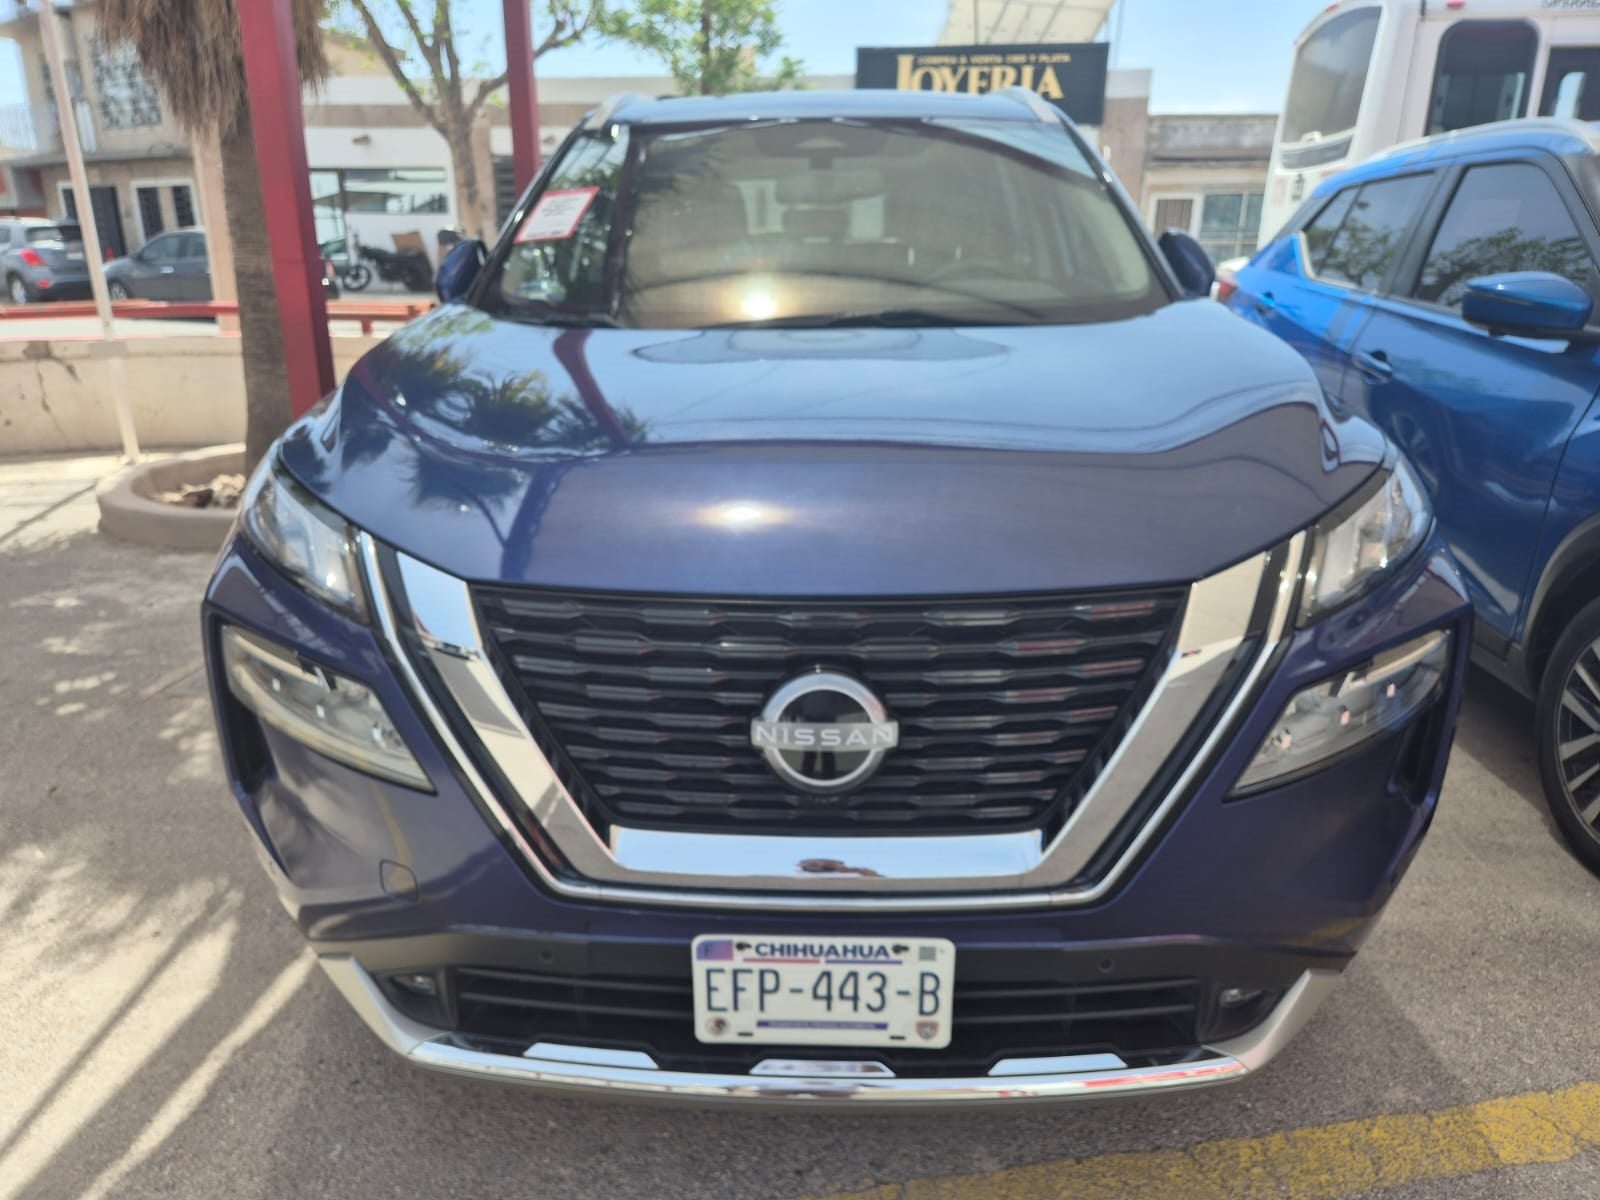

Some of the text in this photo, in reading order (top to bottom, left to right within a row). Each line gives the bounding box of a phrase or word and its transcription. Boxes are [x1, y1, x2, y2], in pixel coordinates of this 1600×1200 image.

[756, 726, 893, 746] NISSAN
[755, 942, 890, 959] CHIHUAHUA
[706, 968, 941, 1017] EFP-443-B
